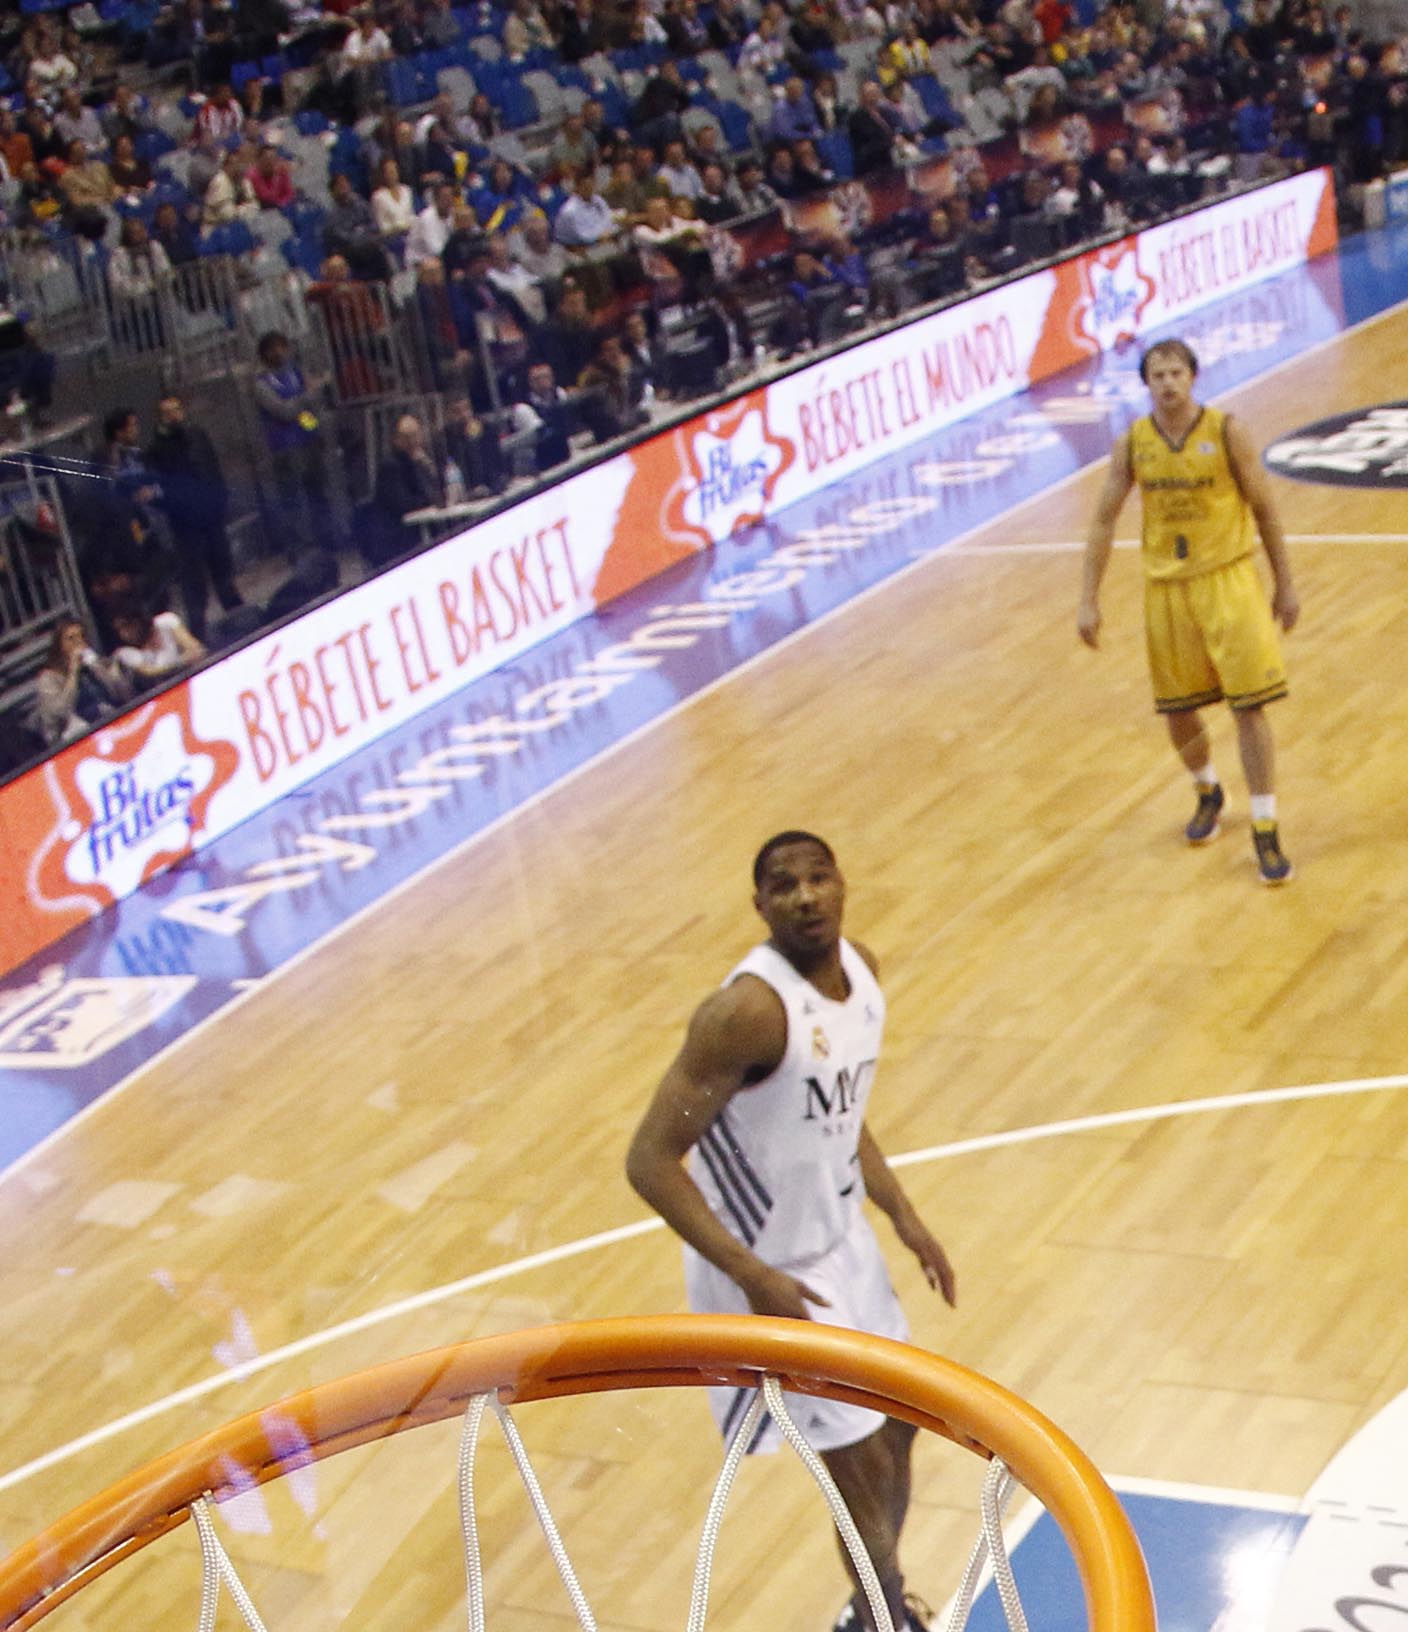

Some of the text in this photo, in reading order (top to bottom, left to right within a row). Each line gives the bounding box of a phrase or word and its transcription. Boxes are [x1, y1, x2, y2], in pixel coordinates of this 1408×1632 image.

[799, 374, 892, 474] BÉBETE
[892, 360, 921, 428] EL
[920, 314, 1017, 414] MUNDO
[238, 516, 582, 783] BÉBETE EL BASKET
[88, 765, 194, 876] frutas
[99, 763, 138, 823] Bi
